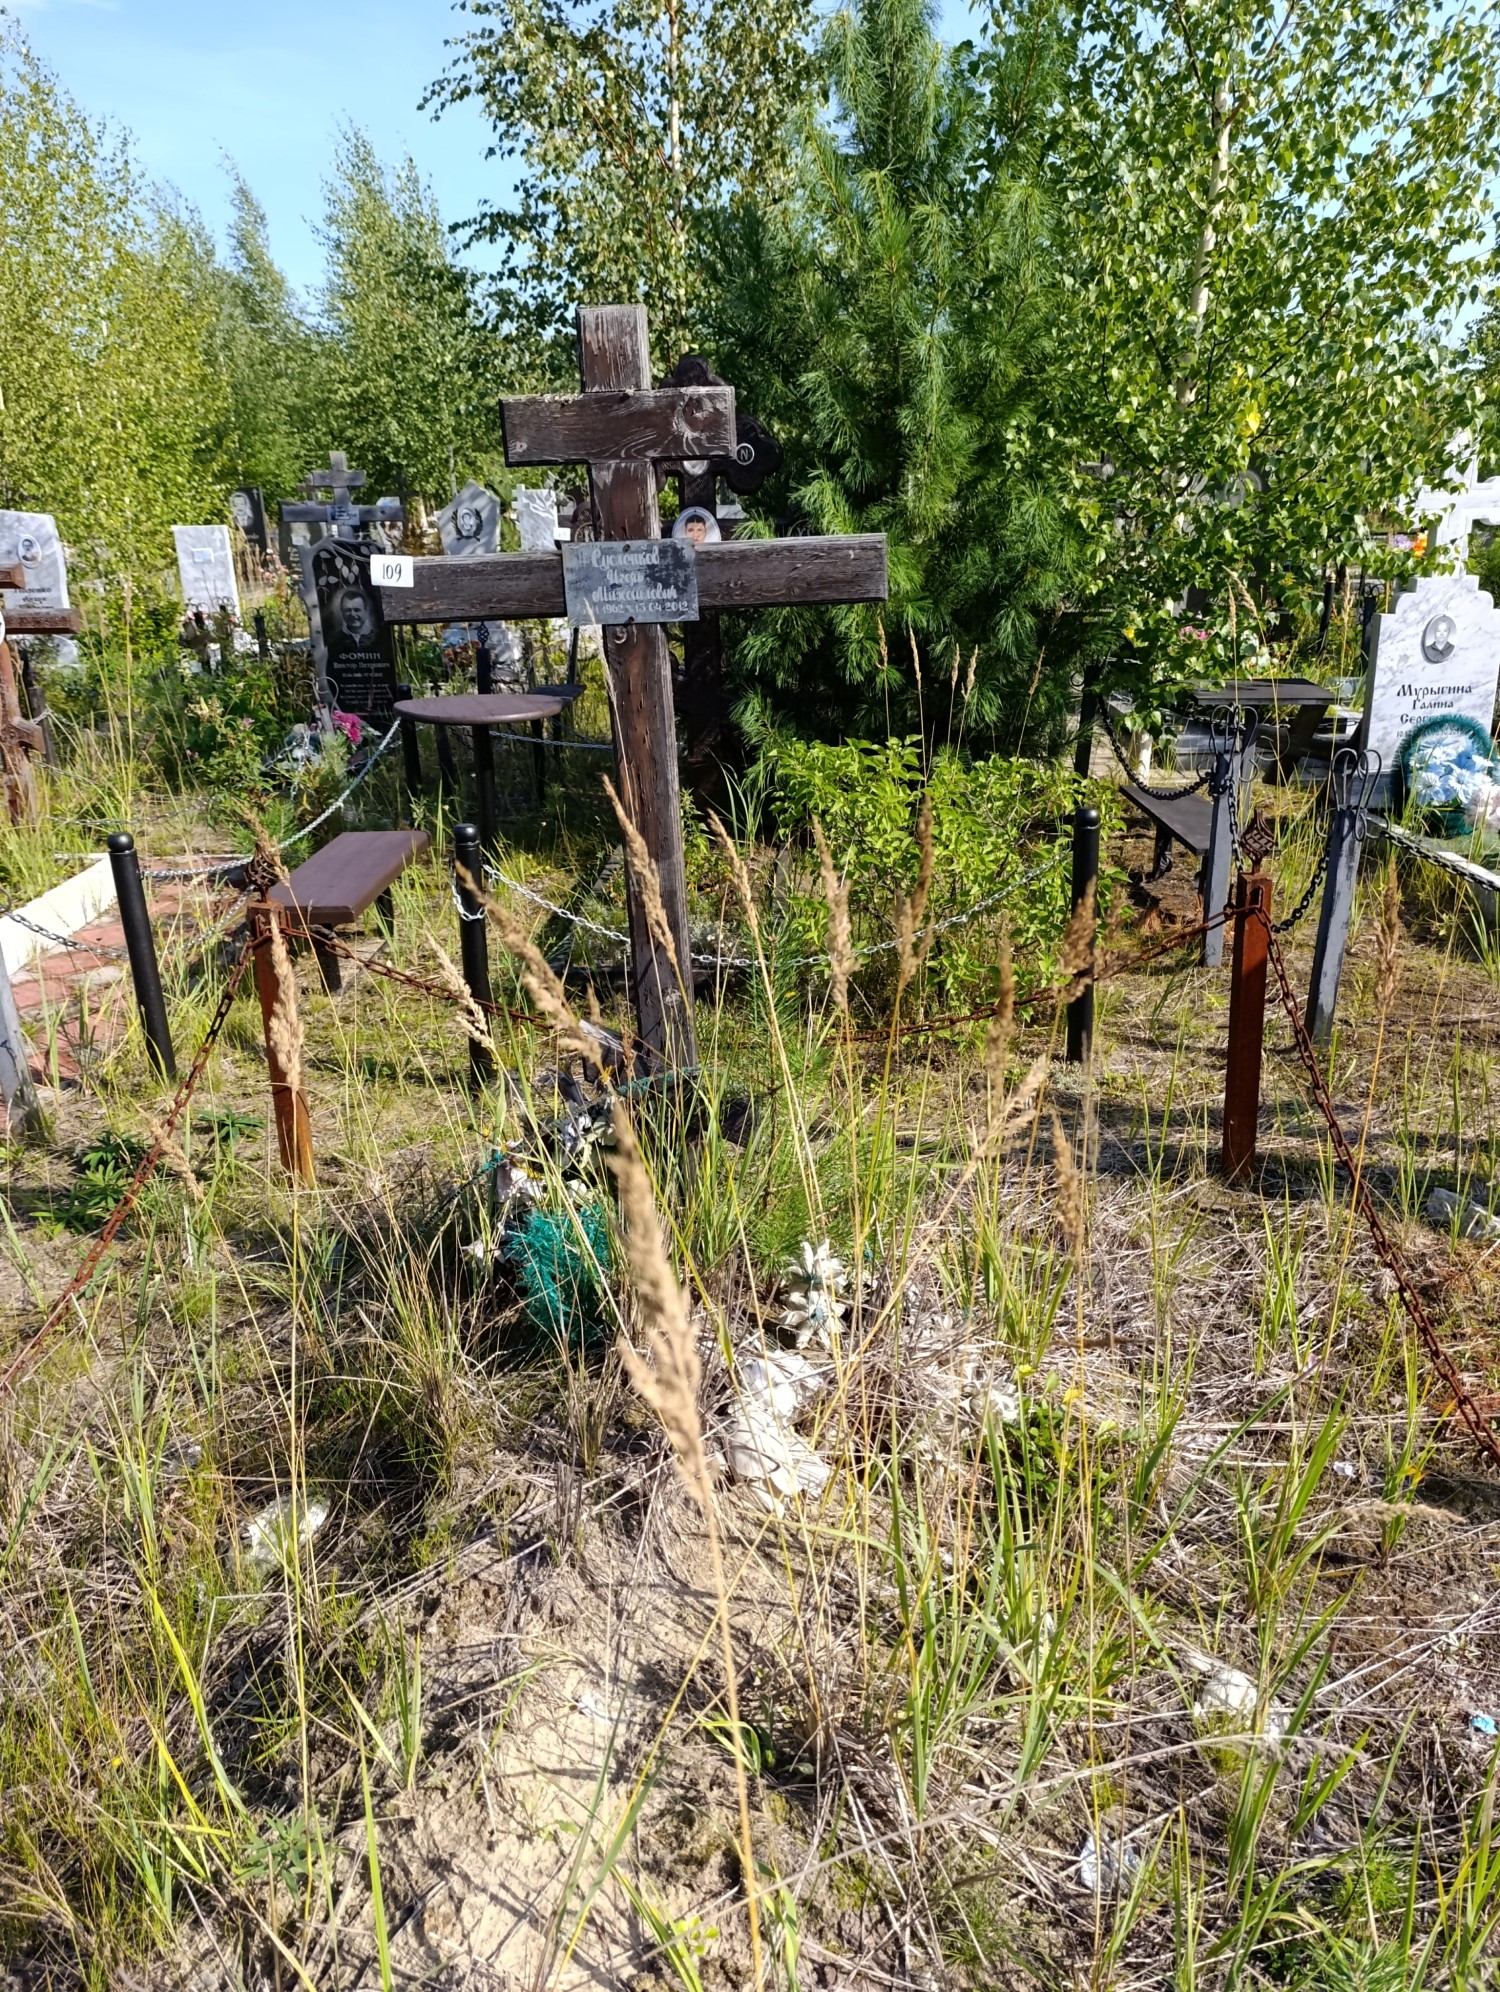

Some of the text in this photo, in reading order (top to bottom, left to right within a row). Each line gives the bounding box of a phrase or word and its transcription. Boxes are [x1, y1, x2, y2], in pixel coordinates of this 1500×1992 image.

[382, 563, 402, 583] 109
[664, 600, 689, 611] 2012
[339, 652, 381, 660] ФОМИН
[1396, 684, 1472, 700] Мурыгина
[1412, 699, 1454, 710] Галина
